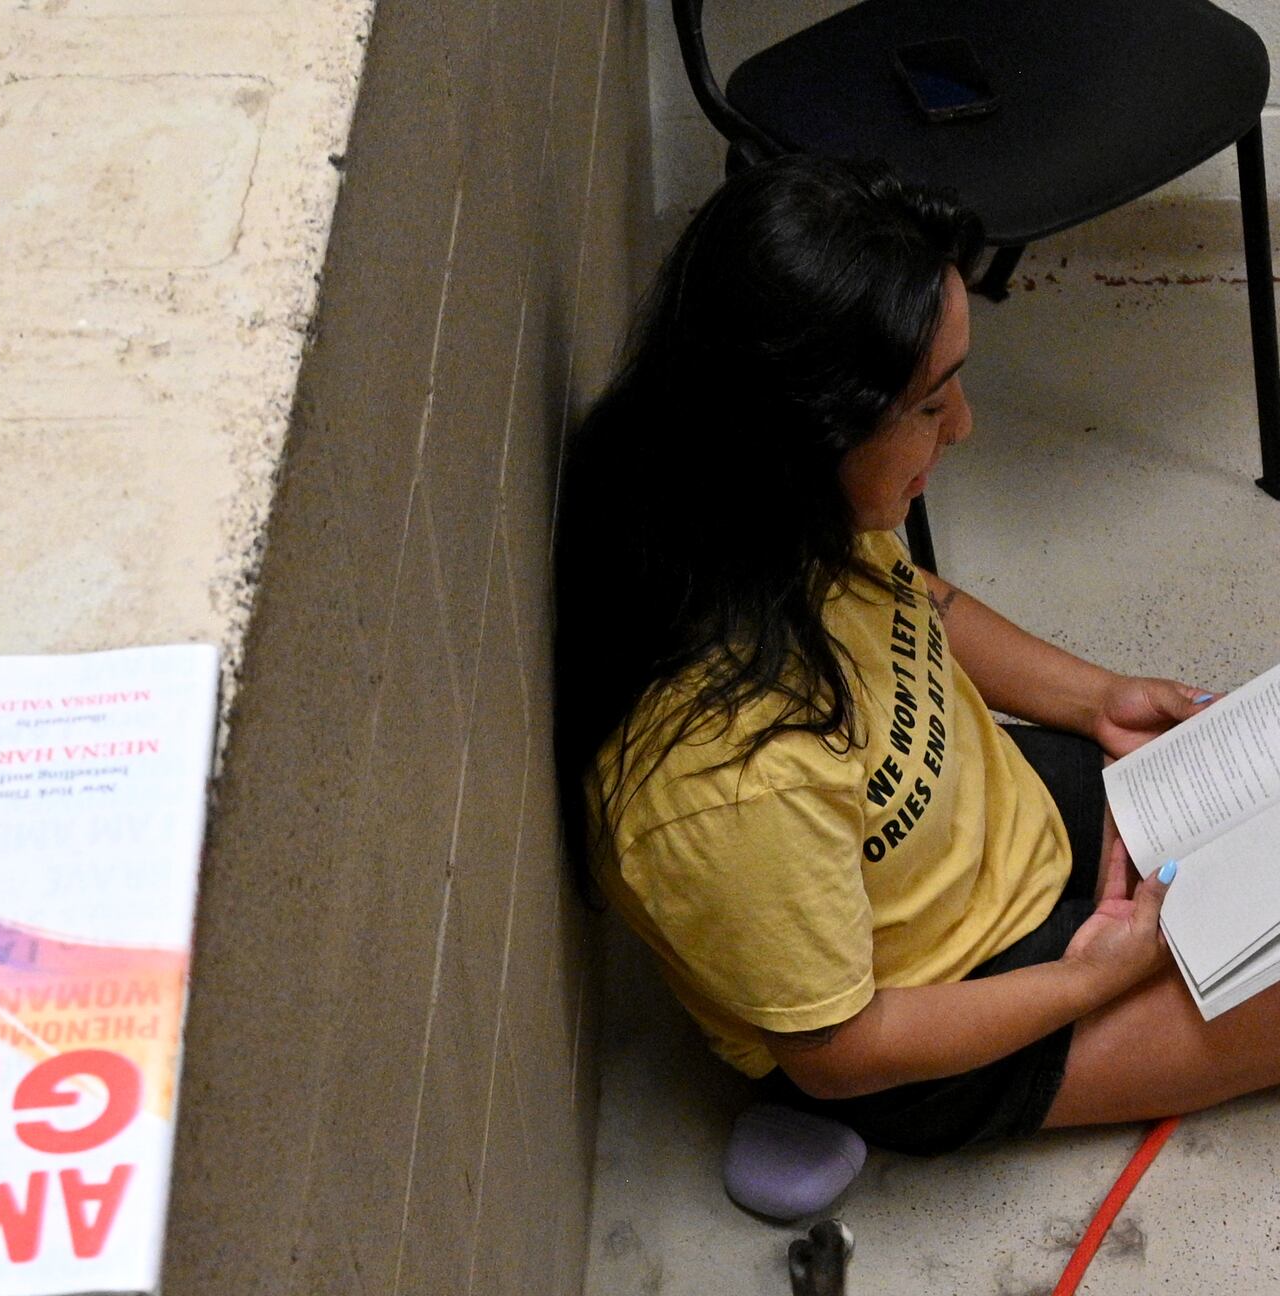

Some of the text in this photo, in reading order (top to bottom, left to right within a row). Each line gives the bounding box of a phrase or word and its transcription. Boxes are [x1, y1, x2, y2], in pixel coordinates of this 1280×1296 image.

[927, 616, 942, 671] THE
[60, 689, 151, 710] MARISSA
[867, 754, 903, 807] WE
[890, 608, 916, 661] LET
[928, 669, 944, 714] AT
[63, 739, 159, 759] MEENA
[923, 714, 945, 778] END
[82, 783, 116, 795] New
